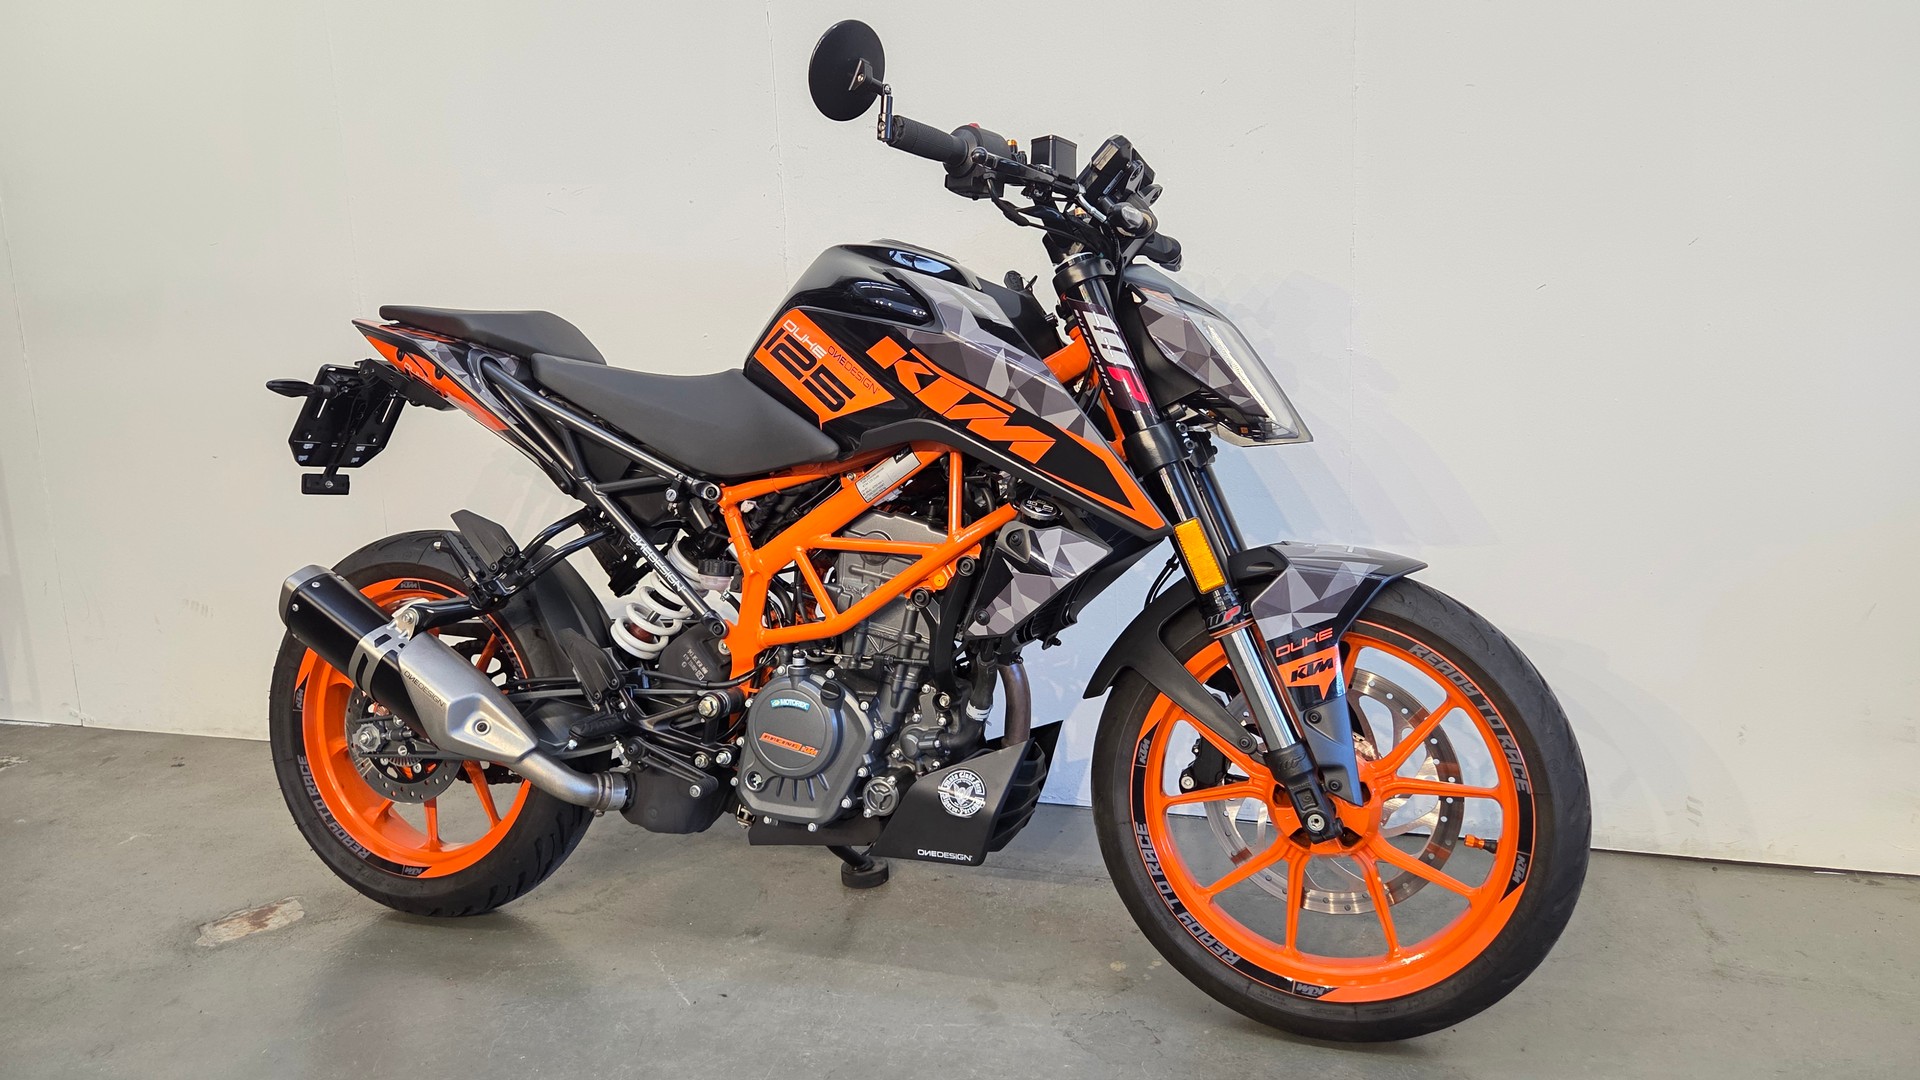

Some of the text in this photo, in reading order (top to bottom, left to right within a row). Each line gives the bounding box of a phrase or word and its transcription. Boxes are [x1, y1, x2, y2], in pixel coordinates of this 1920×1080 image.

[783, 319, 827, 359] DUKE
[1074, 309, 1114, 396] SUSPENSION
[763, 327, 856, 413] 125
[827, 345, 880, 394] ONEDESIGN
[866, 335, 1056, 465] KTM
[630, 532, 685, 591] ONEDESIGN
[1275, 627, 1333, 658] DUKE
[403, 670, 446, 707] ONEDESIGN
[1290, 657, 1334, 683] KTM
[1408, 643, 1530, 794] READY TO RACE
[1138, 738, 1150, 765] KTM
[297, 755, 371, 860] READY TO RACE
[917, 848, 972, 862] ONEDESIGN
[1512, 854, 1527, 884] KTM
[1134, 821, 1241, 966] READY TO RACE
[1296, 983, 1325, 997] KTM
